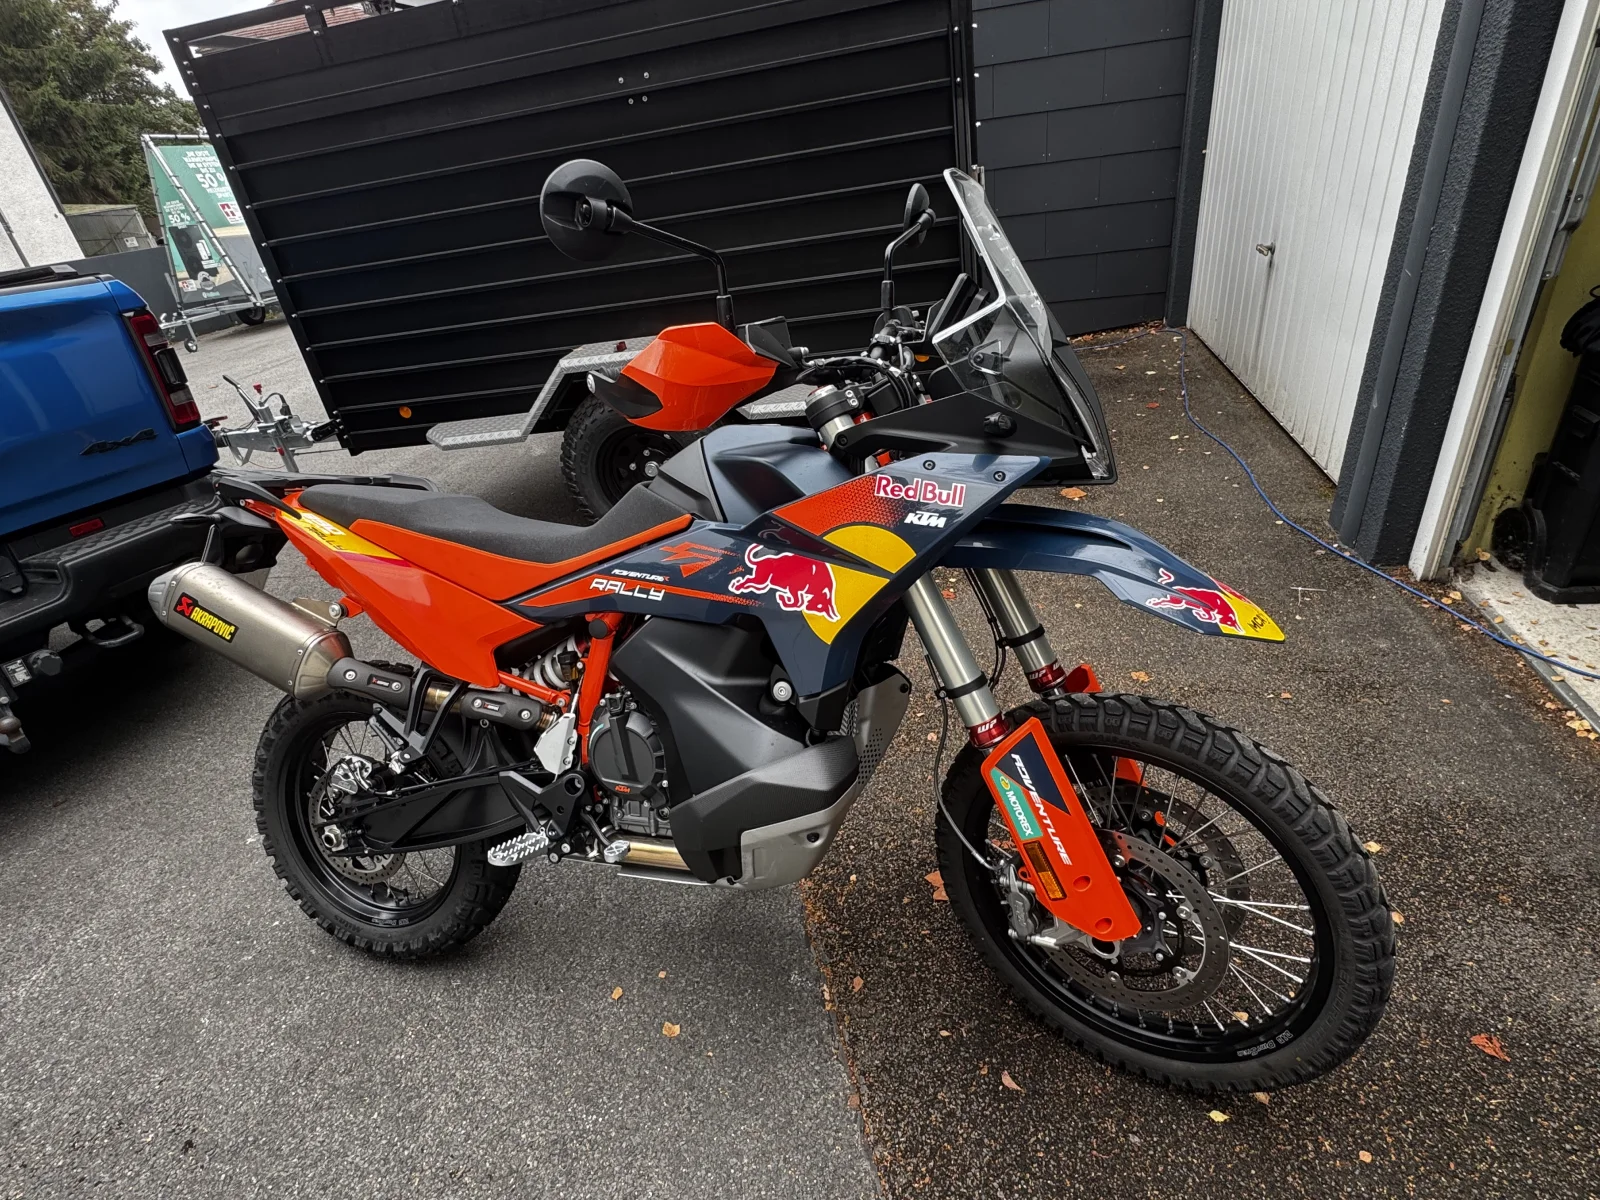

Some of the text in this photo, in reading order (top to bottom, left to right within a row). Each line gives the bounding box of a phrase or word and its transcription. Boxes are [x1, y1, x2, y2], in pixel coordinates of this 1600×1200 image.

[195, 173, 218, 188] 50
[168, 213, 191, 224] 50 %
[875, 474, 966, 507] Red Bull
[904, 511, 947, 528] KTM
[589, 578, 666, 601] RALLY
[977, 718, 997, 734] WP
[615, 785, 630, 793] KTM
[1006, 790, 1034, 836] MOTOREX
[1011, 753, 1073, 866] ADVENTURE
